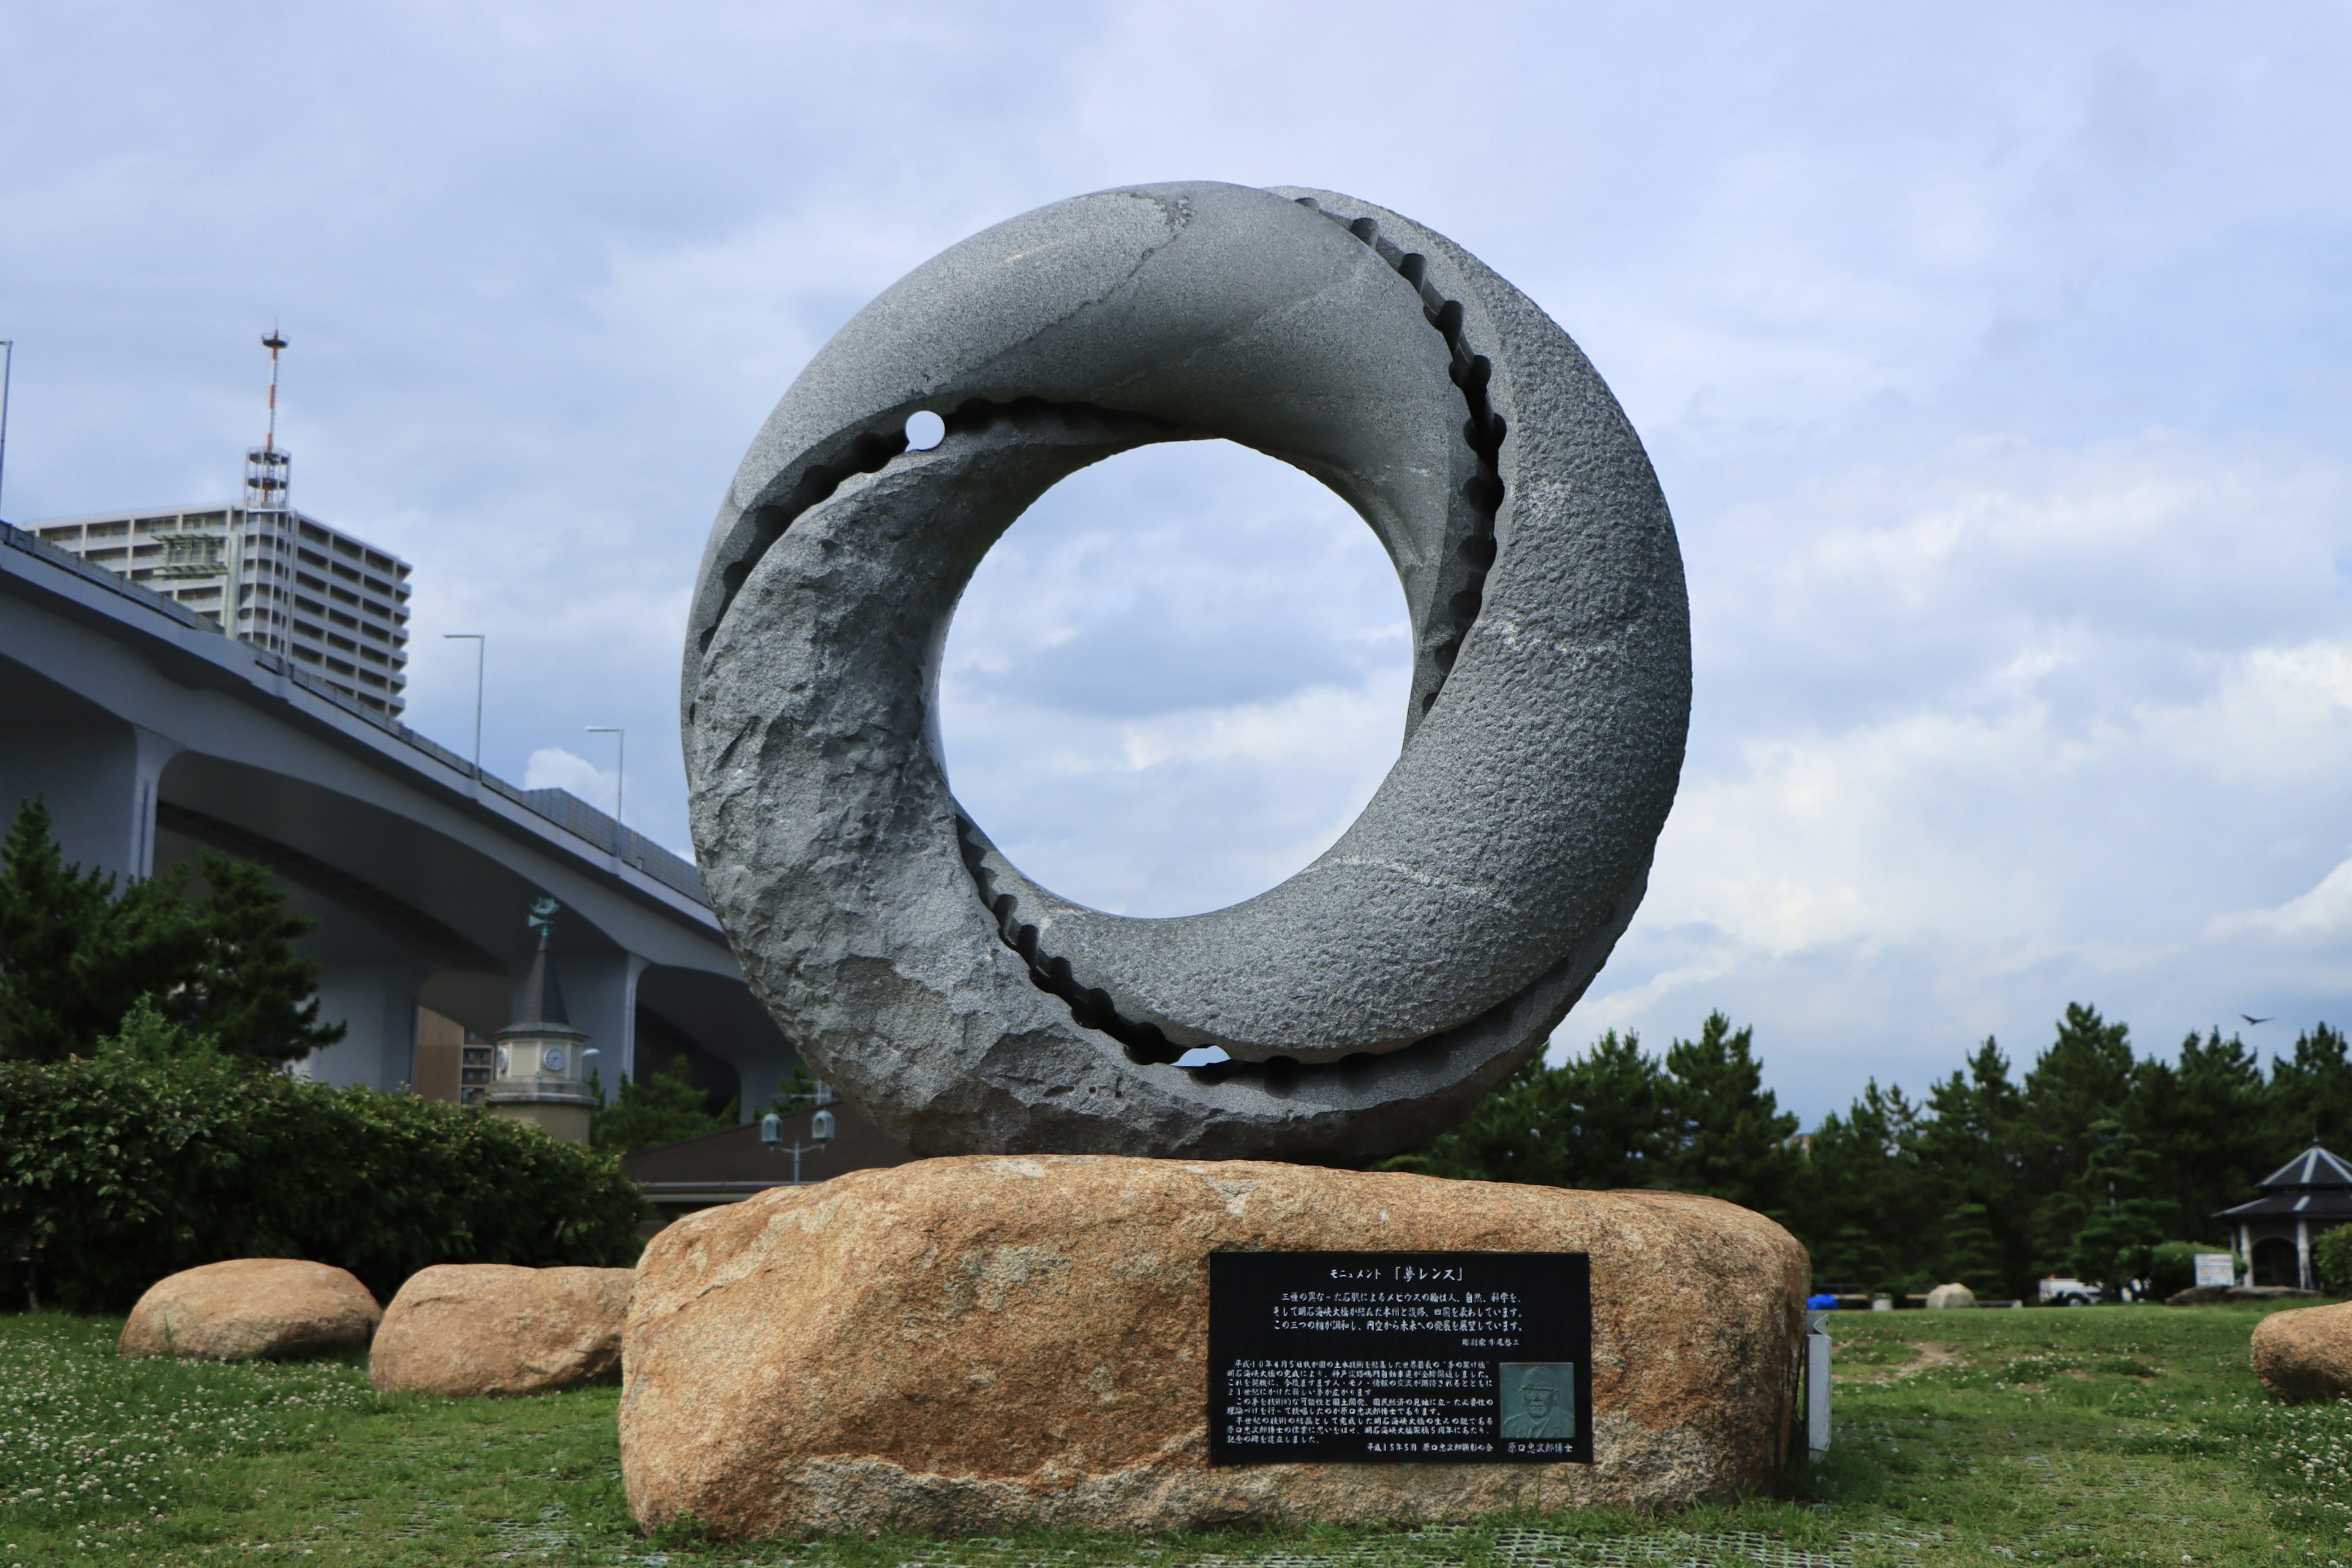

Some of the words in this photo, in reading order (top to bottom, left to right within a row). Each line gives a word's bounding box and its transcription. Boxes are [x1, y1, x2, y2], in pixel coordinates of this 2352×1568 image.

[1330, 1269, 1382, 1279] モニュメント
[1508, 1442, 1574, 1453] 原口忠次郎博士
